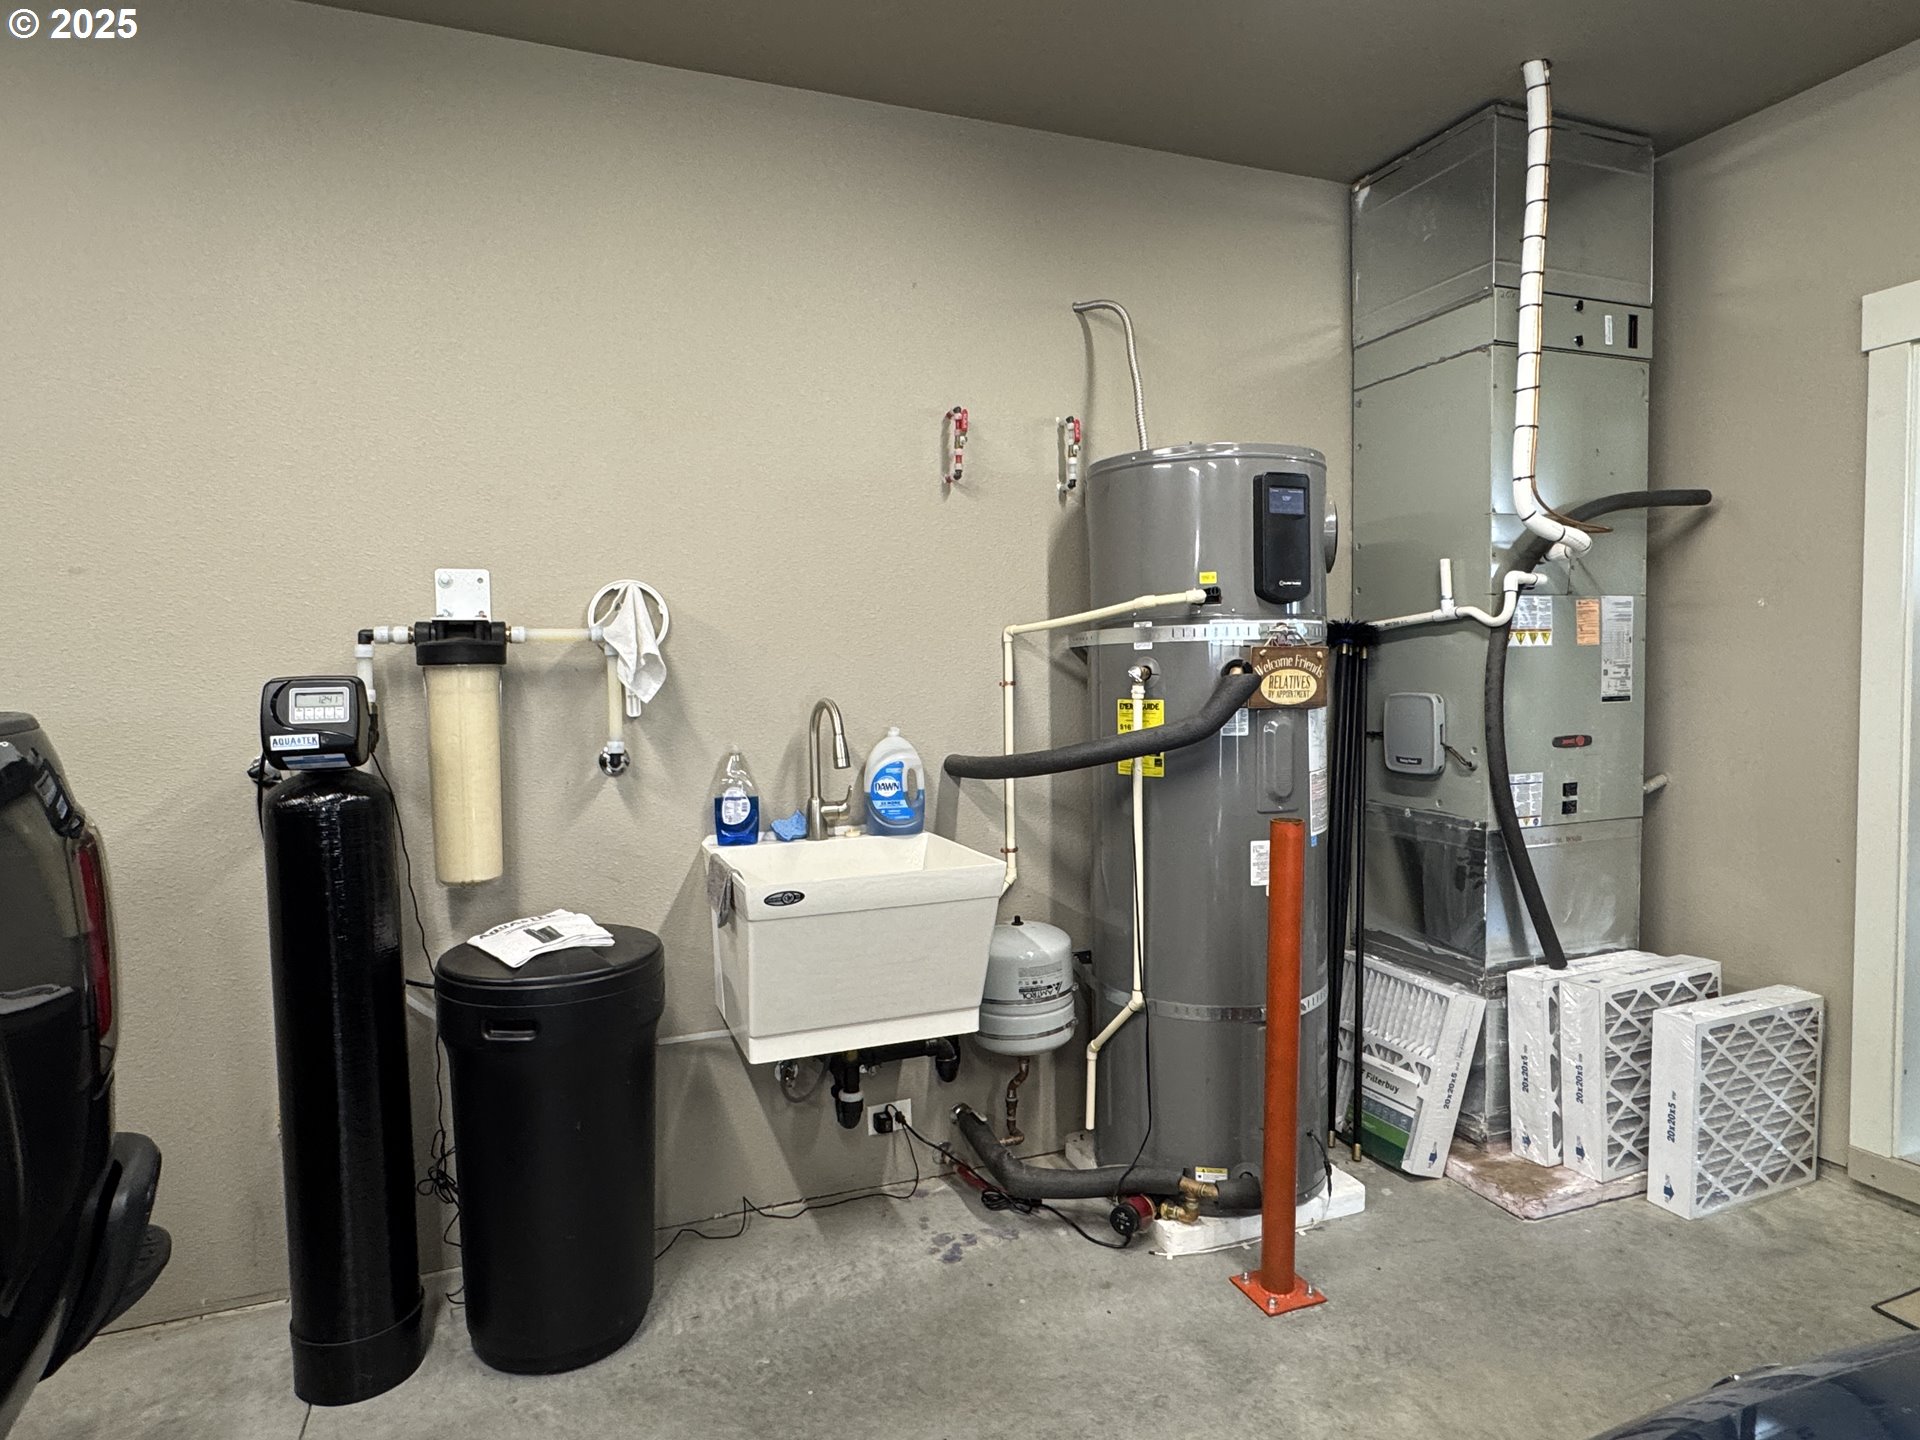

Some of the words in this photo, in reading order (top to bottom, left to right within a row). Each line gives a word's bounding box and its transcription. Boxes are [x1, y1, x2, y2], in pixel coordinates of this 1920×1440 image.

[1254, 657, 1294, 676] Welcome
[1295, 654, 1324, 679] Friends
[1268, 674, 1311, 689] RELATIVES
[1268, 690, 1275, 698] BY
[1276, 689, 1310, 698] APPOINTMENT
[875, 782, 899, 791] DAWN
[1365, 1071, 1400, 1094] Filterbuy
[1521, 1055, 1529, 1093] 20x20x5
[1575, 1065, 1584, 1104] 20x20x5
[1443, 1072, 1458, 1109] 20x20x5
[1667, 1102, 1676, 1143] 20x20x5
